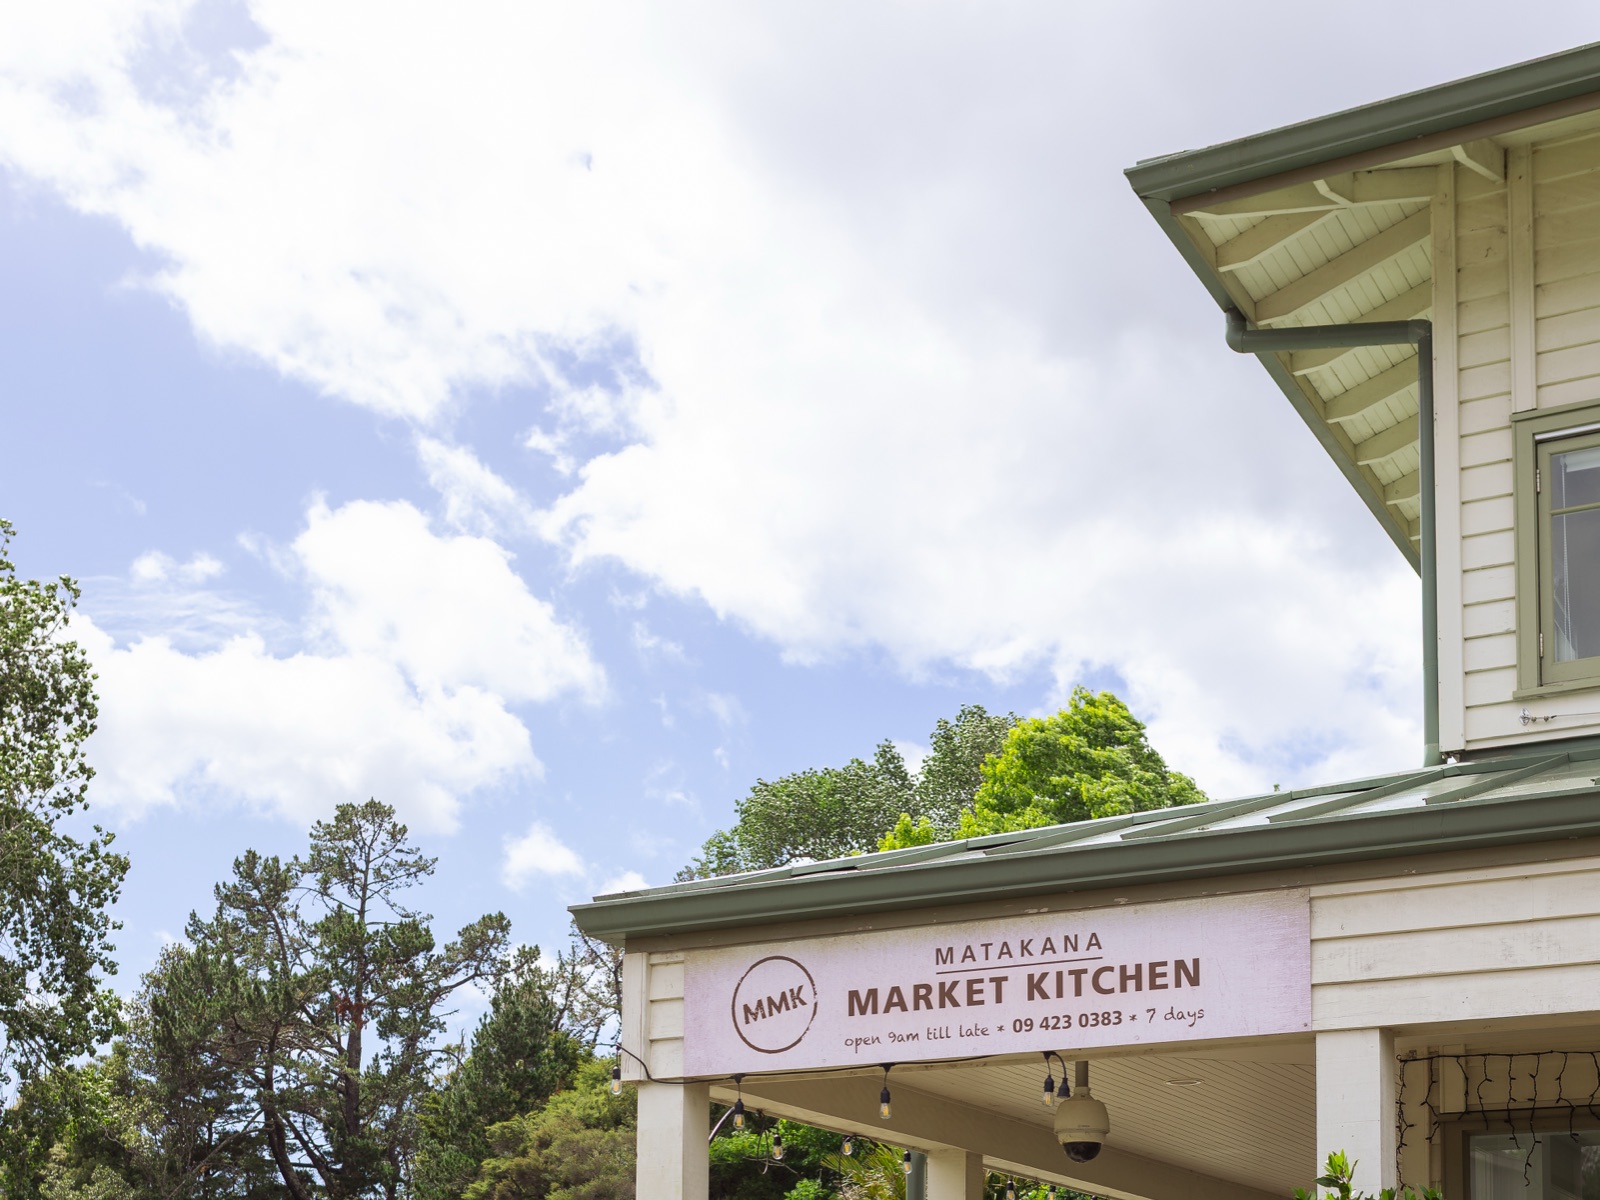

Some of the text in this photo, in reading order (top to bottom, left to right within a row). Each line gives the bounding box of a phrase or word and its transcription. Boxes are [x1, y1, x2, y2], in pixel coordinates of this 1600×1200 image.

[935, 932, 1103, 966] MATAKANA
[847, 957, 1200, 1017] MARKET KITCHEN
[743, 984, 807, 1025] MMK
[1146, 1006, 1205, 1028] 7 days
[1012, 1010, 1123, 1034] 09 423 0383
[844, 1023, 990, 1054] open 9am till late
